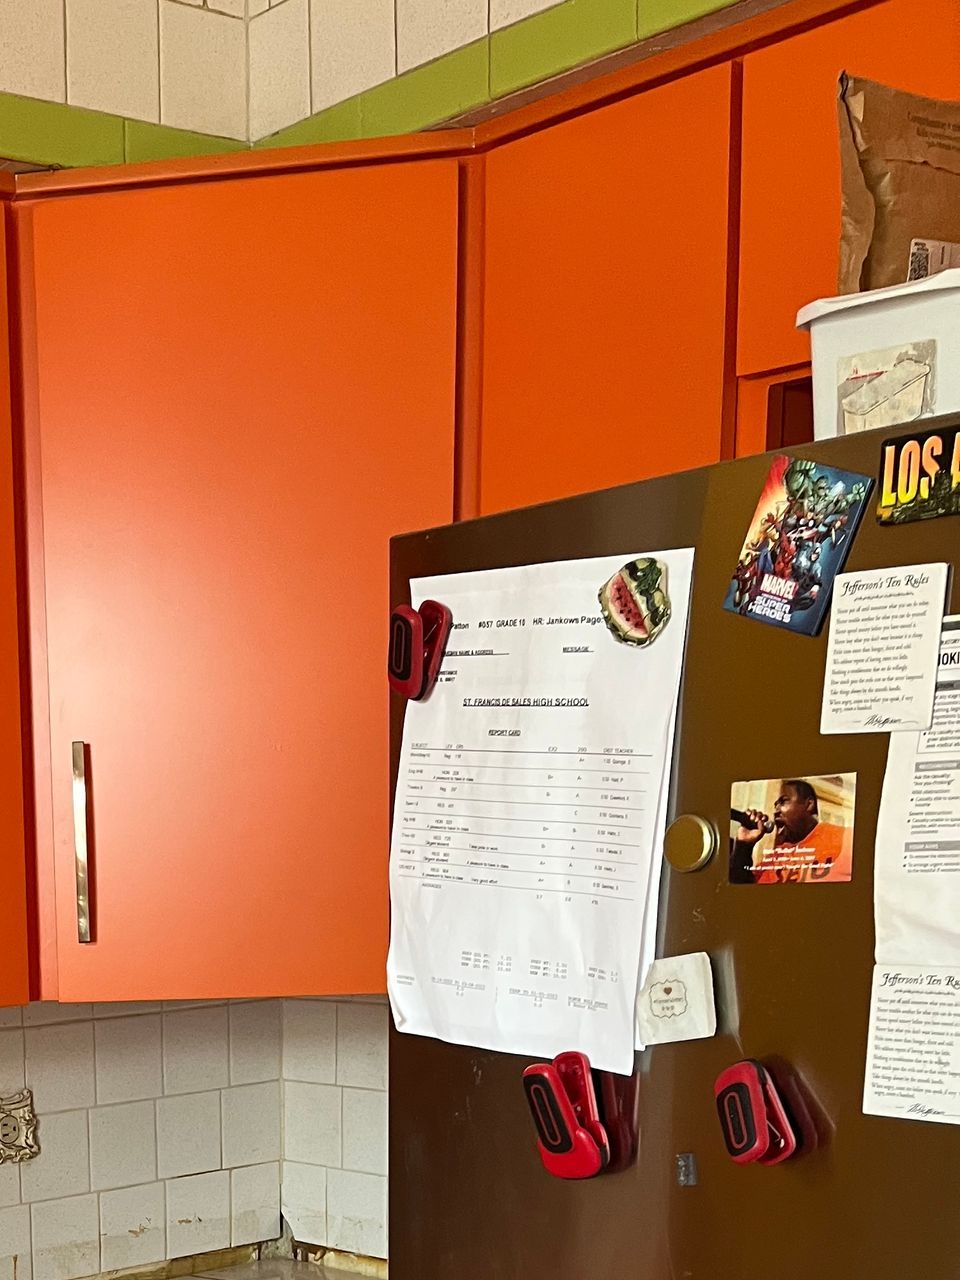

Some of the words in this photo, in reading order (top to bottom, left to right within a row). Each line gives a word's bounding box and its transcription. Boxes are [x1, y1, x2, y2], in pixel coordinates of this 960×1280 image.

[881, 435, 943, 508] LOS
[760, 573, 796, 600] MARVEL
[841, 577, 884, 597] Jefferson's
[885, 576, 901, 588] Ten
[904, 573, 929, 588] Rules
[748, 602, 792, 623] HEROES
[754, 595, 791, 613] SUPER
[496, 619, 518, 628] GRADE
[533, 698, 553, 707] HIGH
[555, 697, 590, 707] SCHOOL
[879, 972, 924, 987] Jefferson's
[926, 974, 942, 986] Ten
